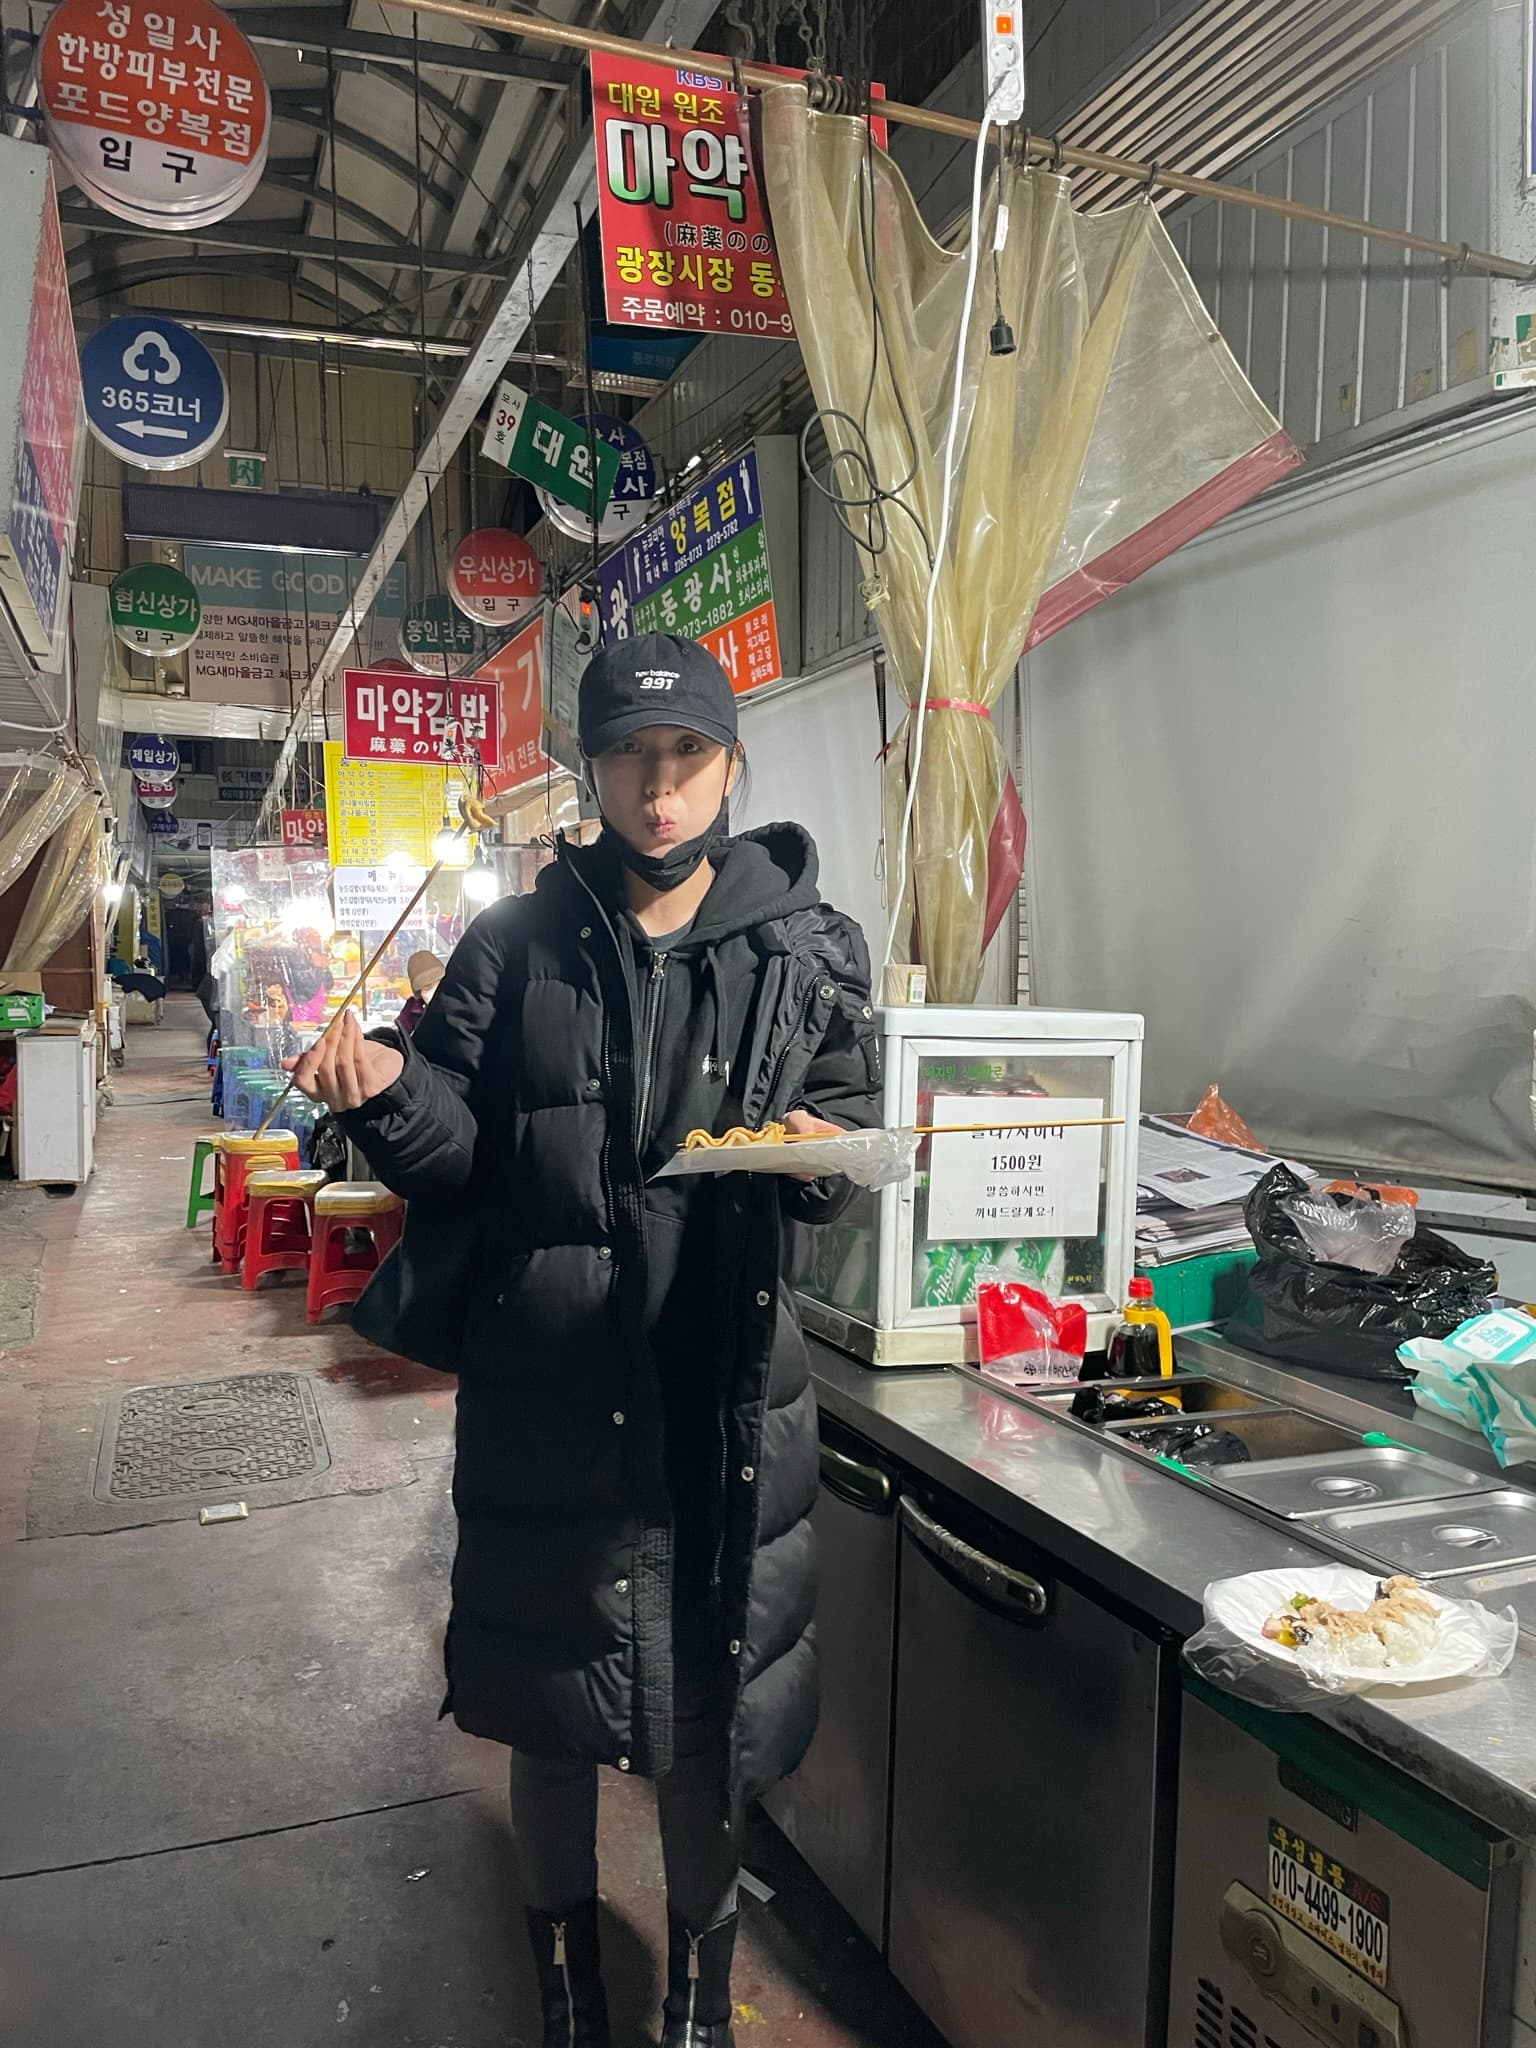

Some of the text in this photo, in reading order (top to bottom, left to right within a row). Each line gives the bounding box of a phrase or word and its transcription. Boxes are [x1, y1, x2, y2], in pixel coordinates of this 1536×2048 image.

[97, 1, 222, 61] 성일사
[57, 32, 254, 115] 한방피부전문
[676, 69, 722, 91] KBS
[52, 81, 252, 156] 포드양복점
[608, 82, 726, 125] 대원 원조
[99, 136, 198, 184] 입구
[605, 118, 749, 223] 마약
[616, 245, 785, 299] 광장시장 동
[621, 296, 706, 326] 주문예약
[101, 387, 201, 423] 365코너
[496, 409, 517, 431] 39
[531, 420, 602, 490] 대원
[670, 476, 737, 555] 양복점
[191, 564, 262, 590] MAKE
[271, 569, 344, 595] GOOD
[457, 556, 535, 585] 우신상가
[115, 587, 198, 623] 협신상가
[483, 598, 521, 612] 입구
[660, 552, 733, 627] 동광사
[134, 628, 176, 646] 입구
[196, 665, 275, 679] MG새마을금고
[635, 669, 681, 680] new balance
[640, 677, 674, 690] 991
[356, 684, 490, 740] 마약김밥
[131, 748, 177, 765] 제일상가
[991, 1154, 1042, 1171] 1500원
[986, 1184, 1044, 1197] 말씀하시면
[1272, 1826, 1345, 1889] 우성냉동
[1271, 1851, 1384, 1964] 010-4499-1900
